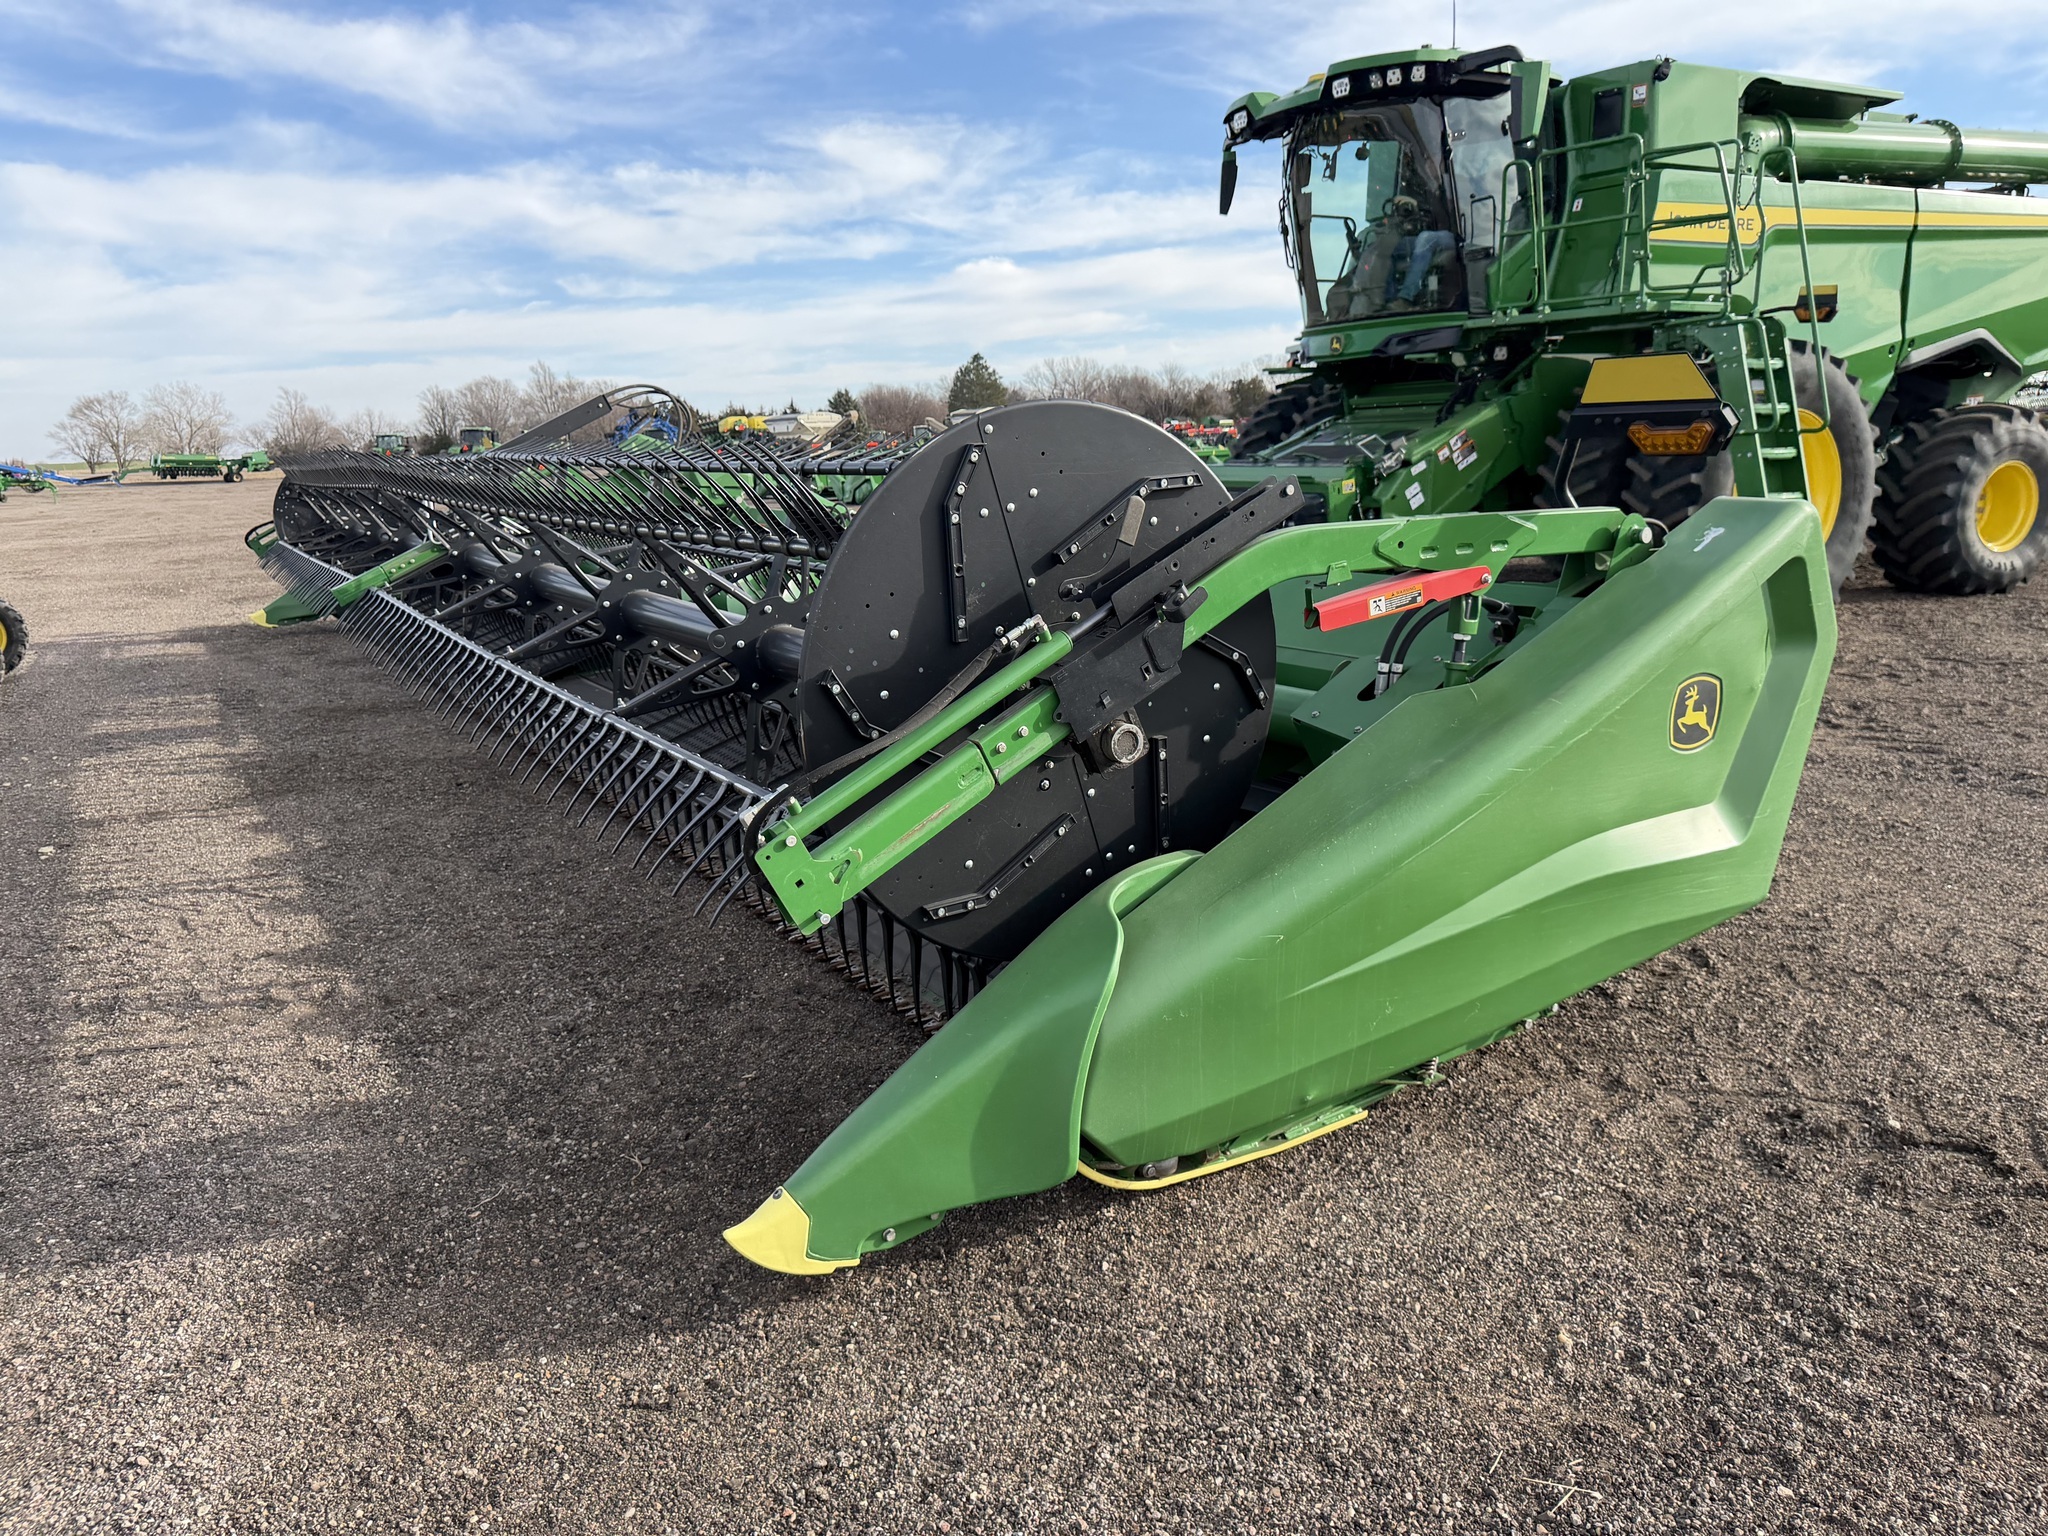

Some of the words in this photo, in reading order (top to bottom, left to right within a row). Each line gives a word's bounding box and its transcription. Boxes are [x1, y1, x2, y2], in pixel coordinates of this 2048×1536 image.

[1706, 217, 1755, 231] DERE
[1241, 513, 1250, 524] 3
[1202, 540, 1210, 551] 2
[1164, 566, 1170, 575] 1
